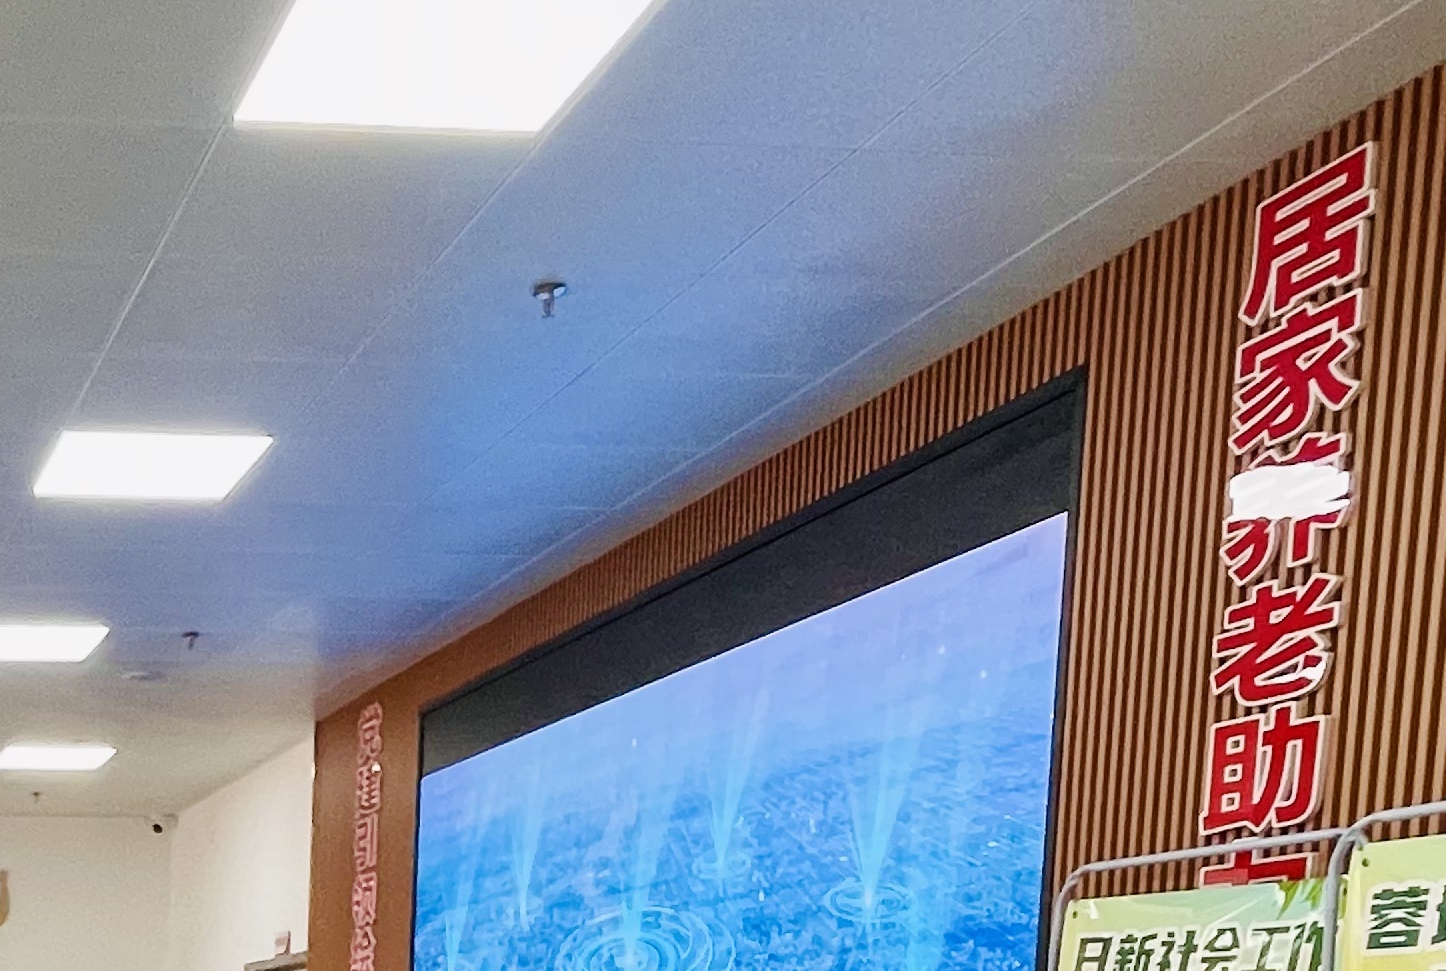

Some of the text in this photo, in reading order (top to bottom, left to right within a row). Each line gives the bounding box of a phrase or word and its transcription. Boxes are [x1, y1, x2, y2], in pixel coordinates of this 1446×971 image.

[1199, 140, 1377, 888] 居家养老助
[1366, 884, 1446, 950] 蓉
